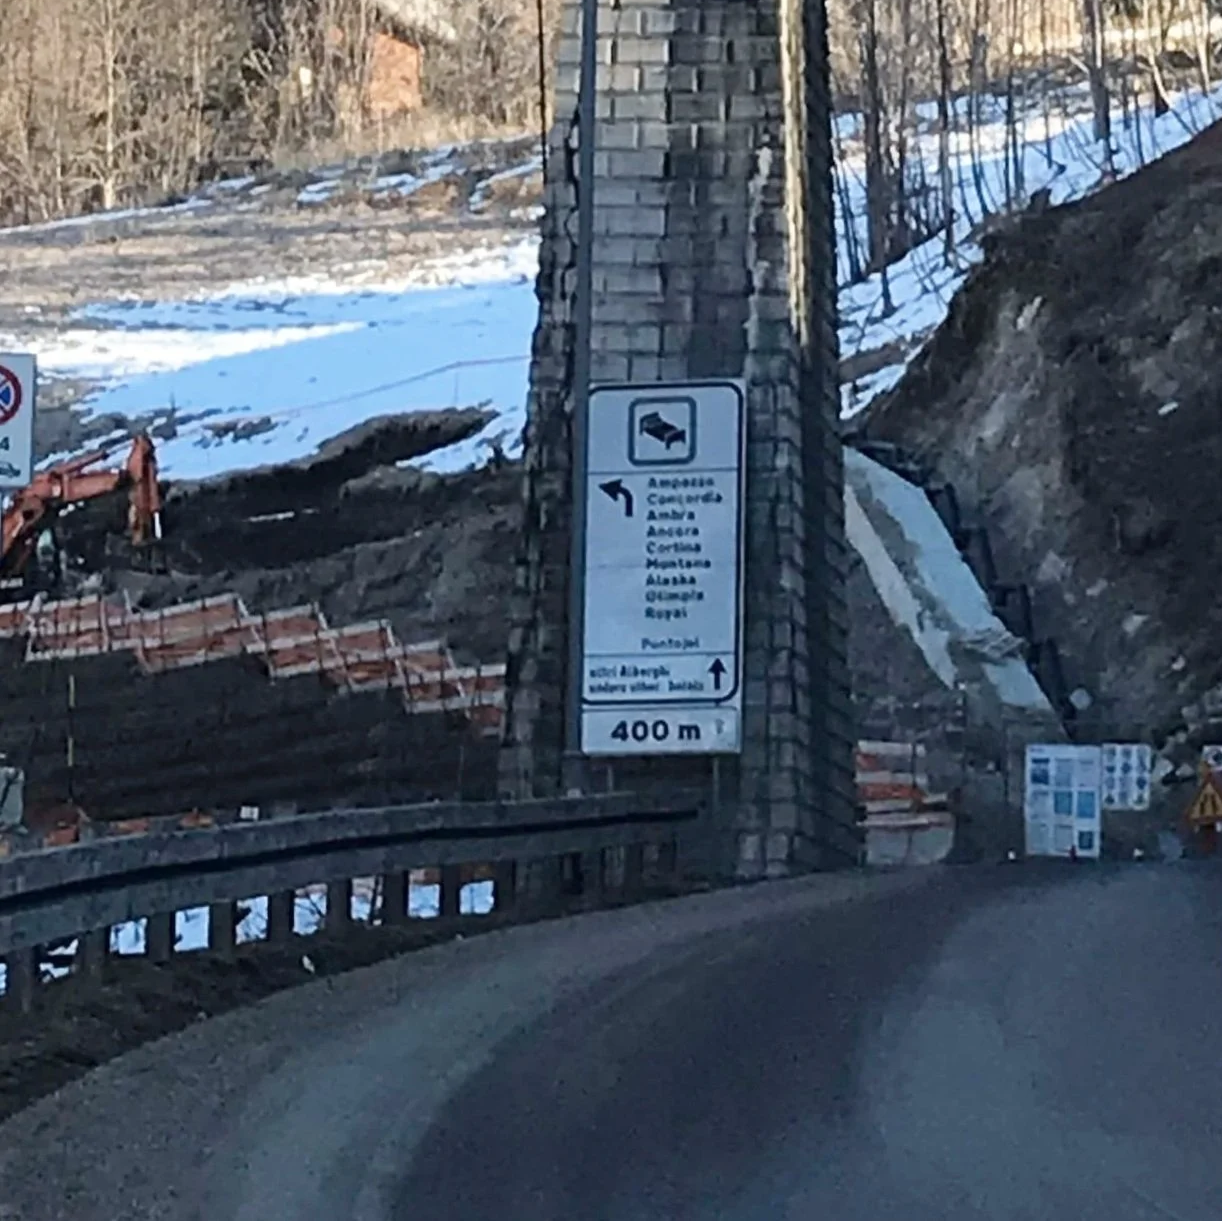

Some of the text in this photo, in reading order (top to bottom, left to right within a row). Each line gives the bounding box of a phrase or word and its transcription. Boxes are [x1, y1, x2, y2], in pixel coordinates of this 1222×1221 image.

[646, 490, 723, 505] Concordia
[646, 508, 695, 521] Ambra
[646, 525, 699, 538] Ancora
[646, 541, 702, 554] Cortina
[645, 558, 711, 570] Montana
[645, 573, 696, 586] Alaska
[645, 589, 704, 603] Olimpia
[645, 606, 688, 622] Royal
[610, 719, 701, 742] 400 m
